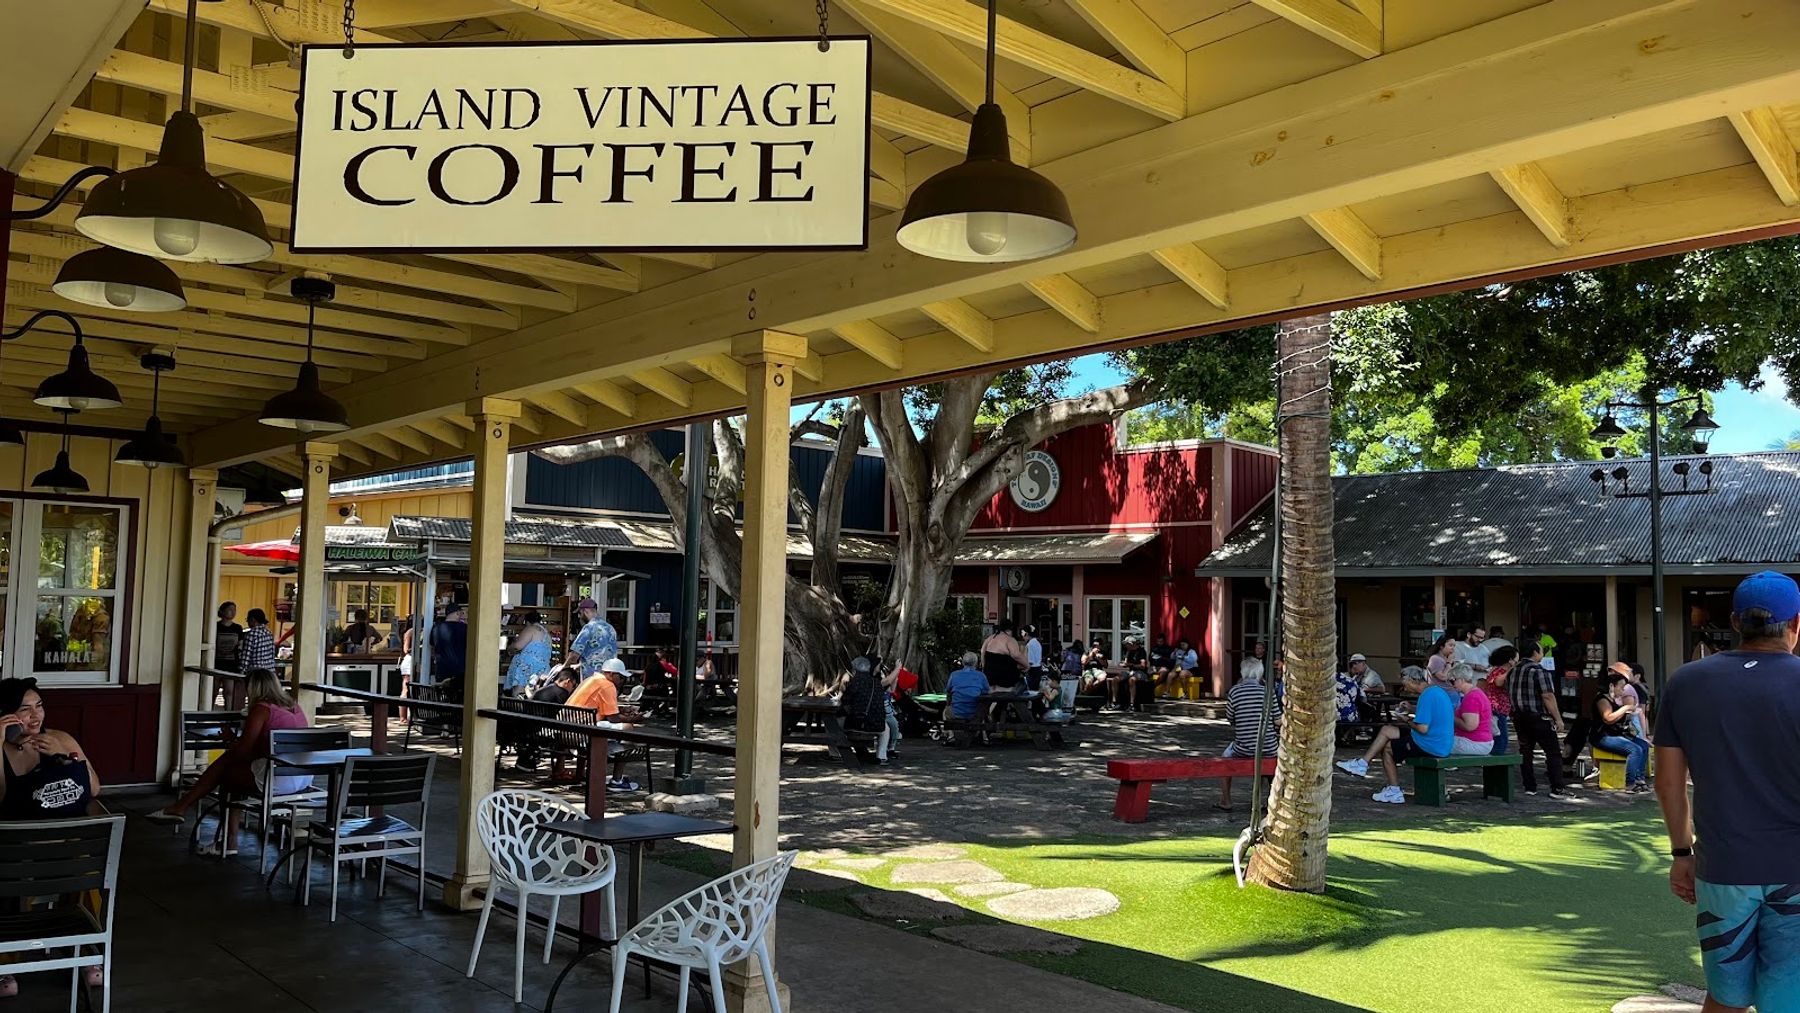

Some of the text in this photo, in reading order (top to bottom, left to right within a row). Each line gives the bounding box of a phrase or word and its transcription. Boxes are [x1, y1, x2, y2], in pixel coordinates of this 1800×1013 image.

[333, 83, 836, 131] ISLAND VINTAGE
[344, 141, 813, 205] COFFEE
[328, 547, 390, 560] HALEIWA
